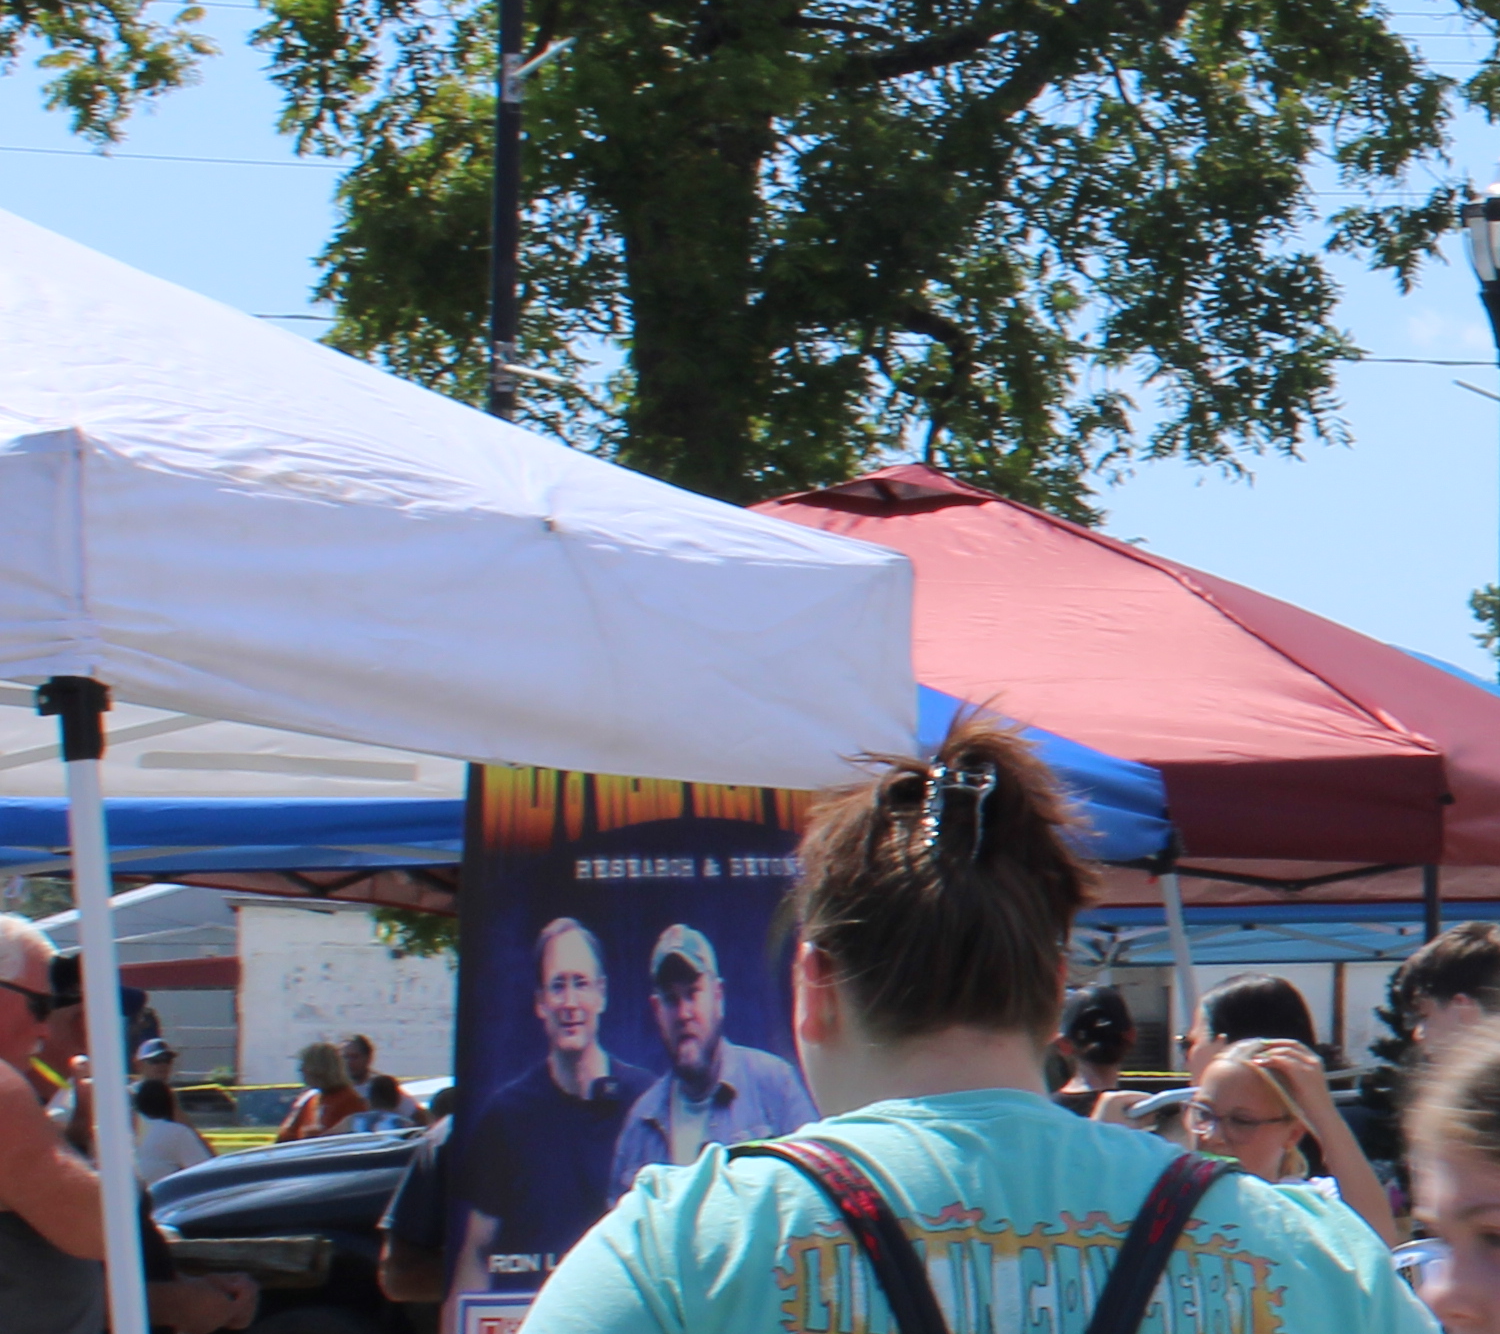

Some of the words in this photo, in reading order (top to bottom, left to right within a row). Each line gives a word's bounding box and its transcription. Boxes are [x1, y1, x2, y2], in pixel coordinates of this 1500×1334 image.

[575, 857, 695, 879] RESEARCH
[703, 859, 721, 877] &
[729, 857, 805, 877] BEYON
[489, 1253, 540, 1273] RON
